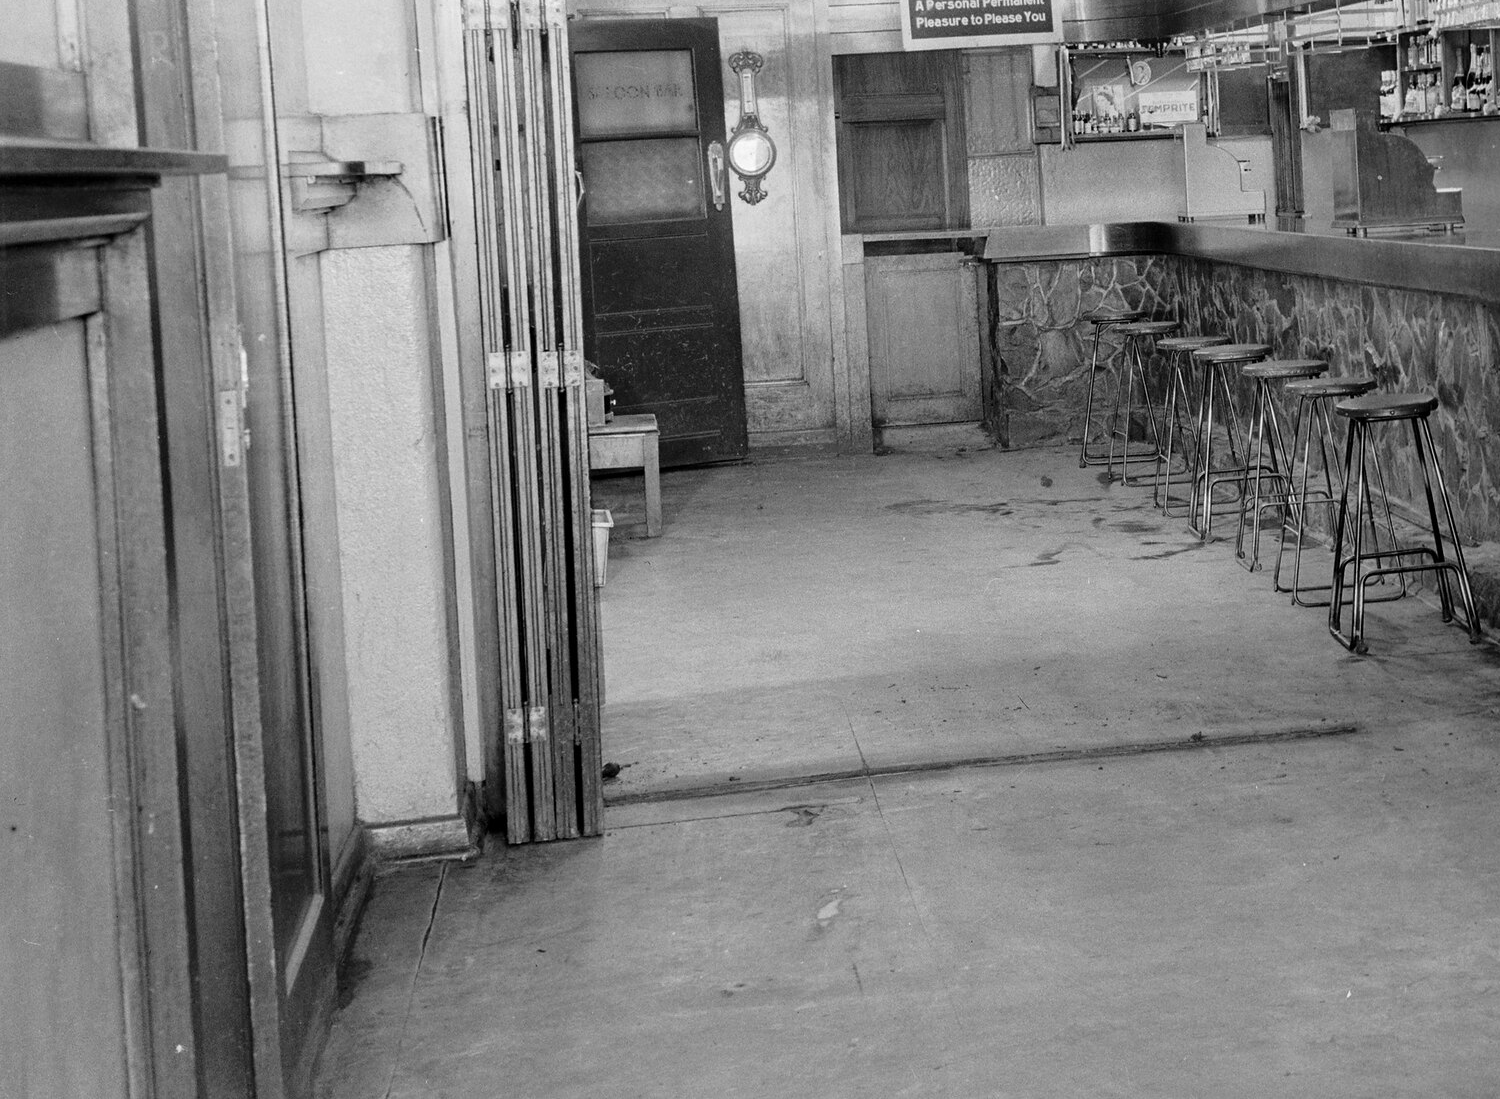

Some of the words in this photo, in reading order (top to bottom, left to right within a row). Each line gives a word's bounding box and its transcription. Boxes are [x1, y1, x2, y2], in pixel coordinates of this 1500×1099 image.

[915, 0, 924, 12] A
[915, 15, 969, 29] Pleasure
[970, 13, 983, 26] to
[984, 12, 1023, 25] Please
[1023, 10, 1046, 23] You
[587, 83, 651, 101] SLOON
